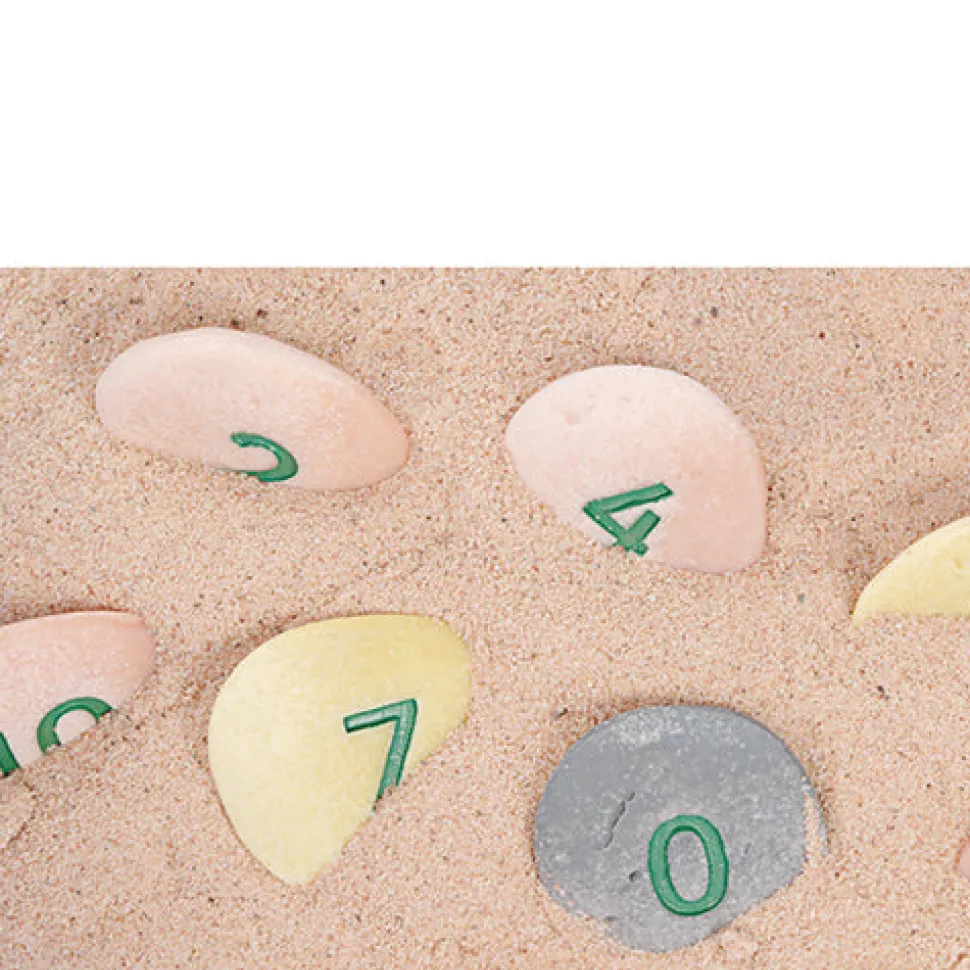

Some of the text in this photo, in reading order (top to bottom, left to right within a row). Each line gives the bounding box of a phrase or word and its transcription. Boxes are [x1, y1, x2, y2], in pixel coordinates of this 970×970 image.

[582, 482, 675, 557] 4
[343, 697, 419, 800] 7
[646, 814, 731, 917] 0
